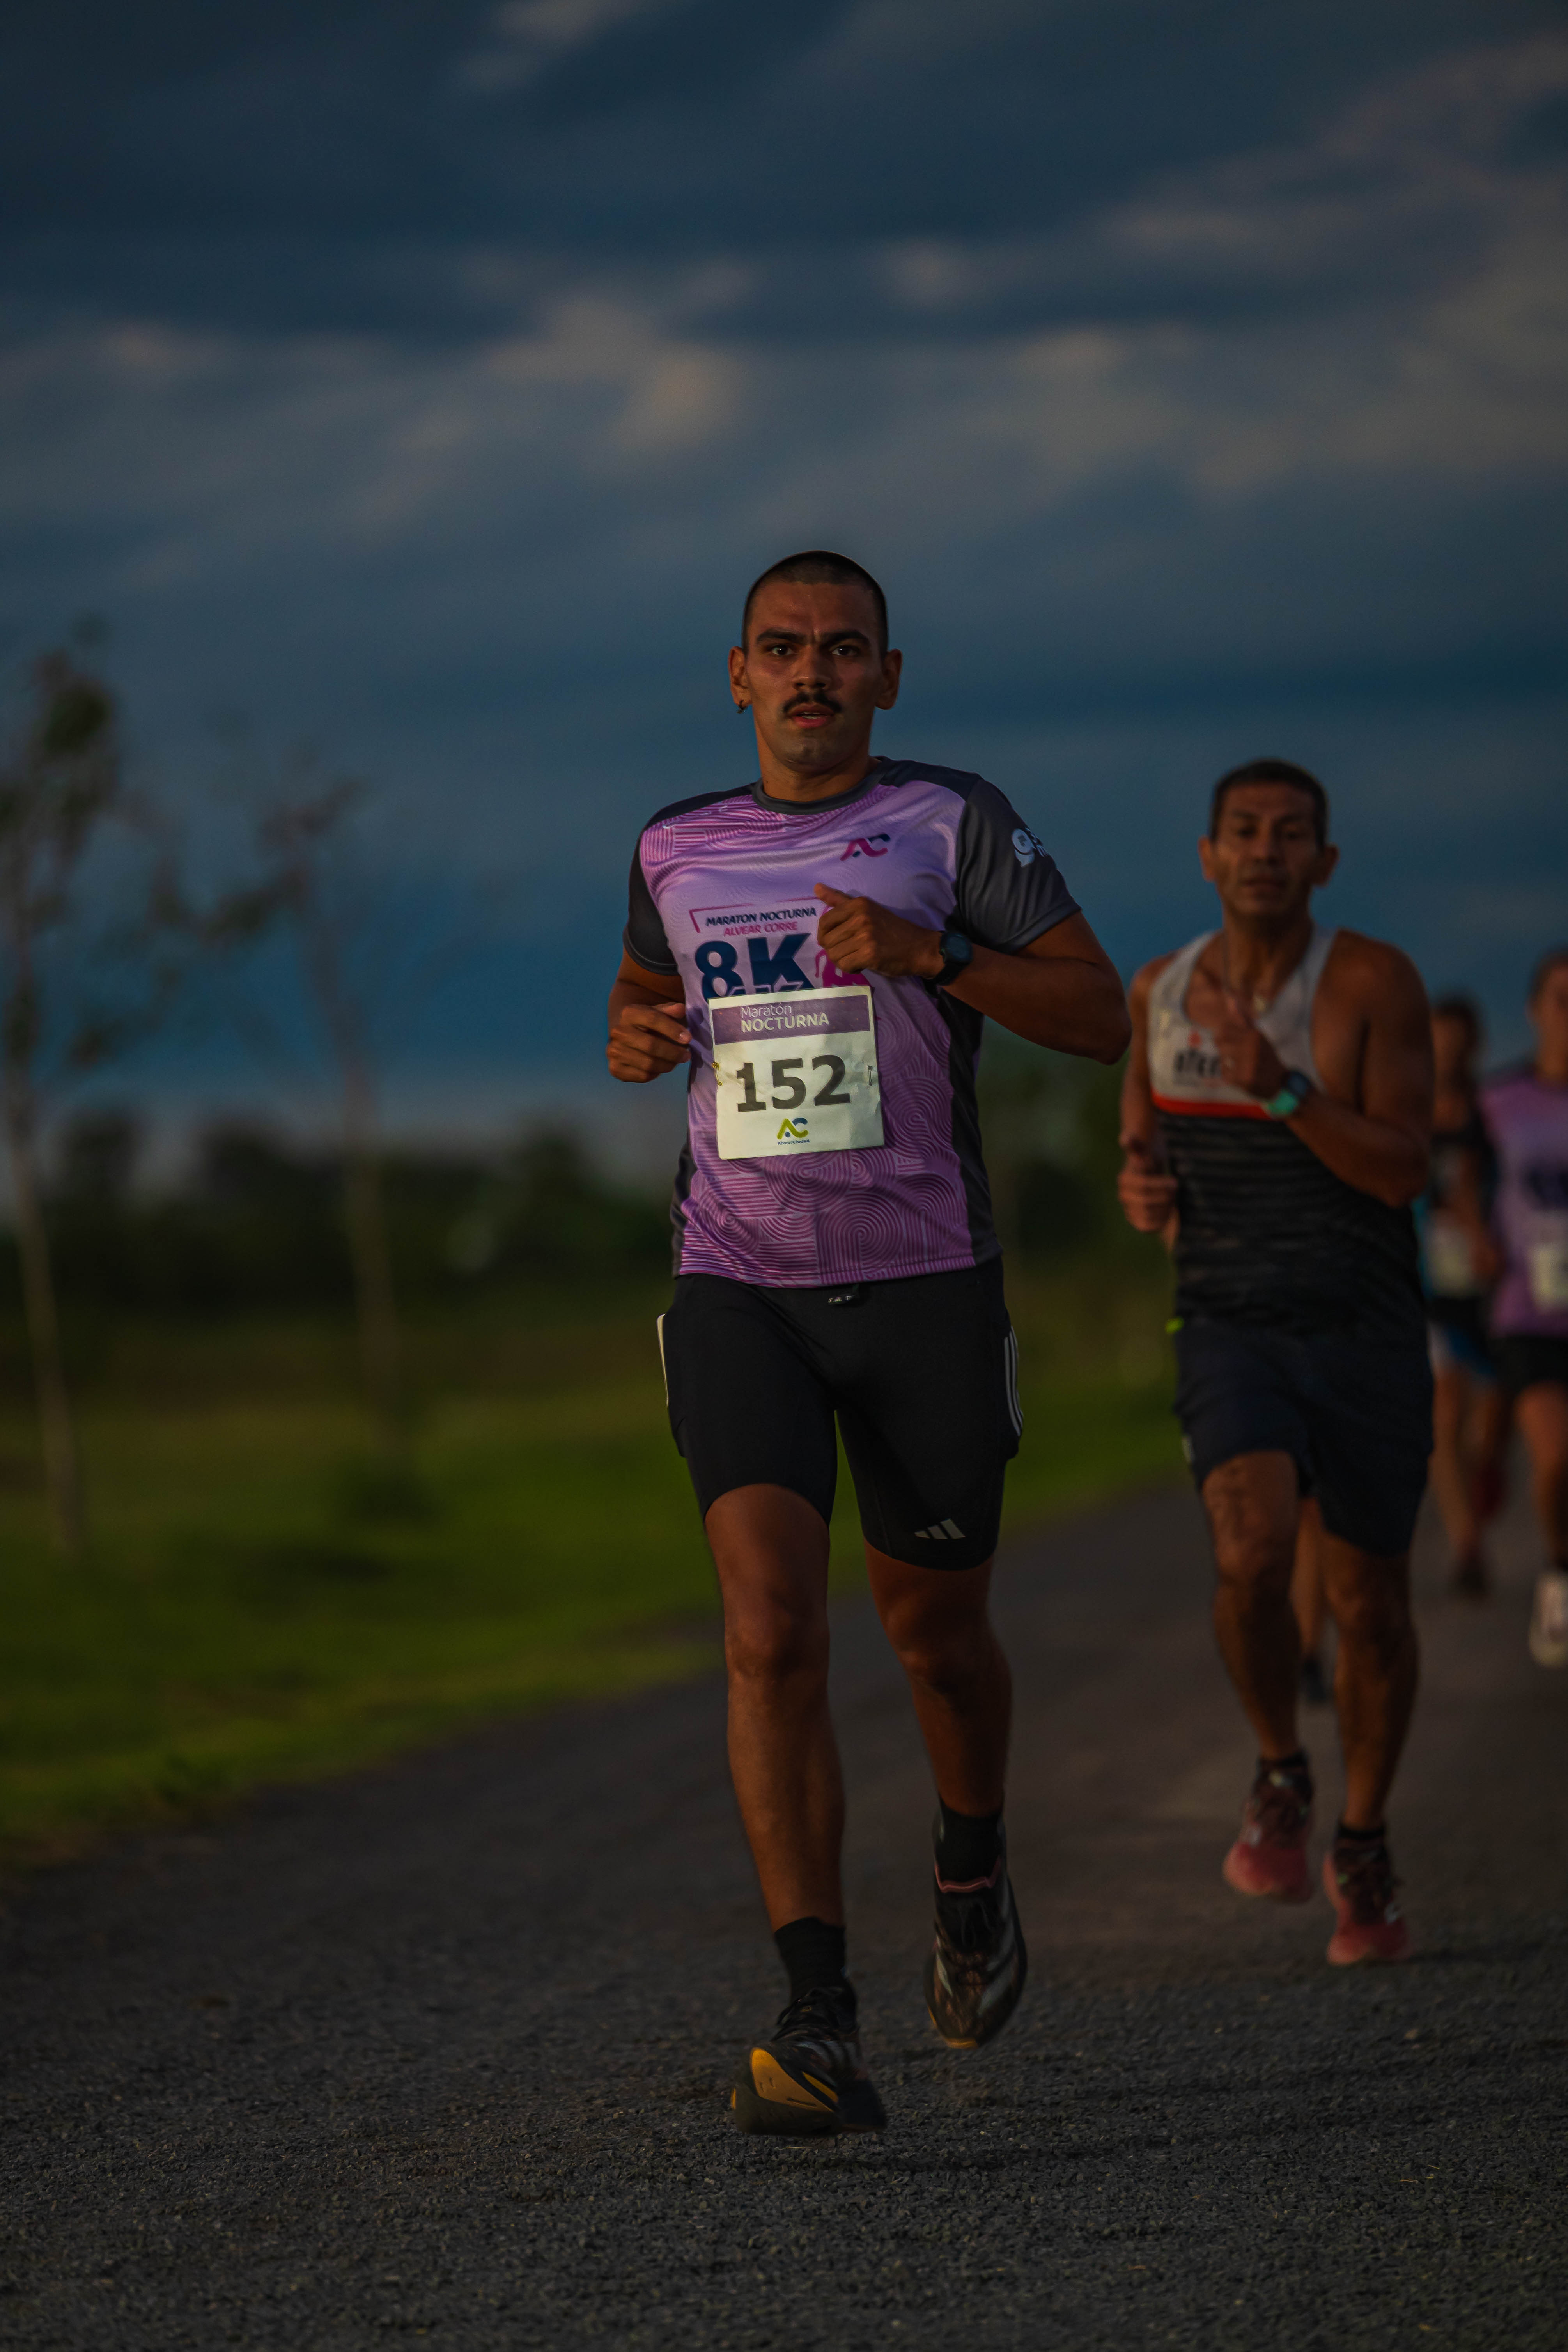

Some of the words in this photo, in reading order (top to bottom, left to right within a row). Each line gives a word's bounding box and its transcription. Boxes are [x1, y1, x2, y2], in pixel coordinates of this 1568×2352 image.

[706, 913, 757, 927] MARATON
[760, 907, 817, 922] NOCTURNA
[724, 924, 762, 937] ALVEAR
[764, 921, 798, 933] CORRE
[695, 933, 816, 1004] 8K
[741, 1002, 792, 1018] Maratón
[742, 1013, 830, 1033] NOCTURNA
[736, 1054, 851, 1112] 152
